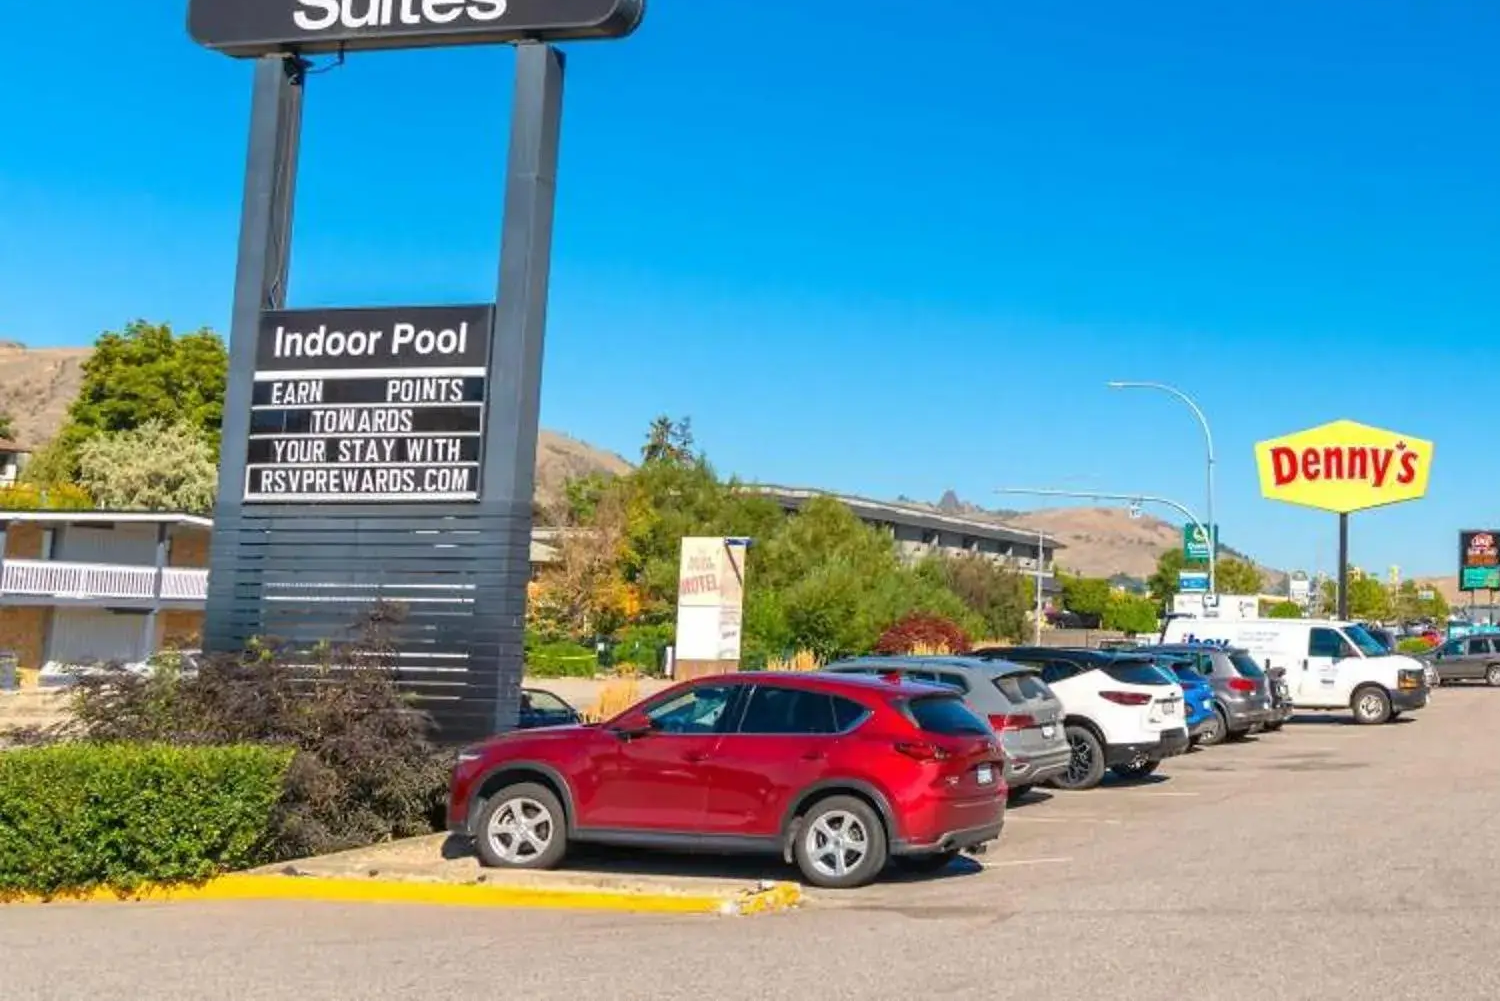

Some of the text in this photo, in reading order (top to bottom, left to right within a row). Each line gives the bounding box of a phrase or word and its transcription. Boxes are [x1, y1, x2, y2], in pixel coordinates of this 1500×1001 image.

[274, 321, 468, 357] Indoor Pool
[271, 378, 464, 405] EARN POINTS
[311, 409, 413, 433] TOWARDS
[273, 438, 461, 463] YOUR STAY WITH
[1271, 441, 1418, 487] Denny's
[260, 468, 469, 493] RSVPREWARDS.COM
